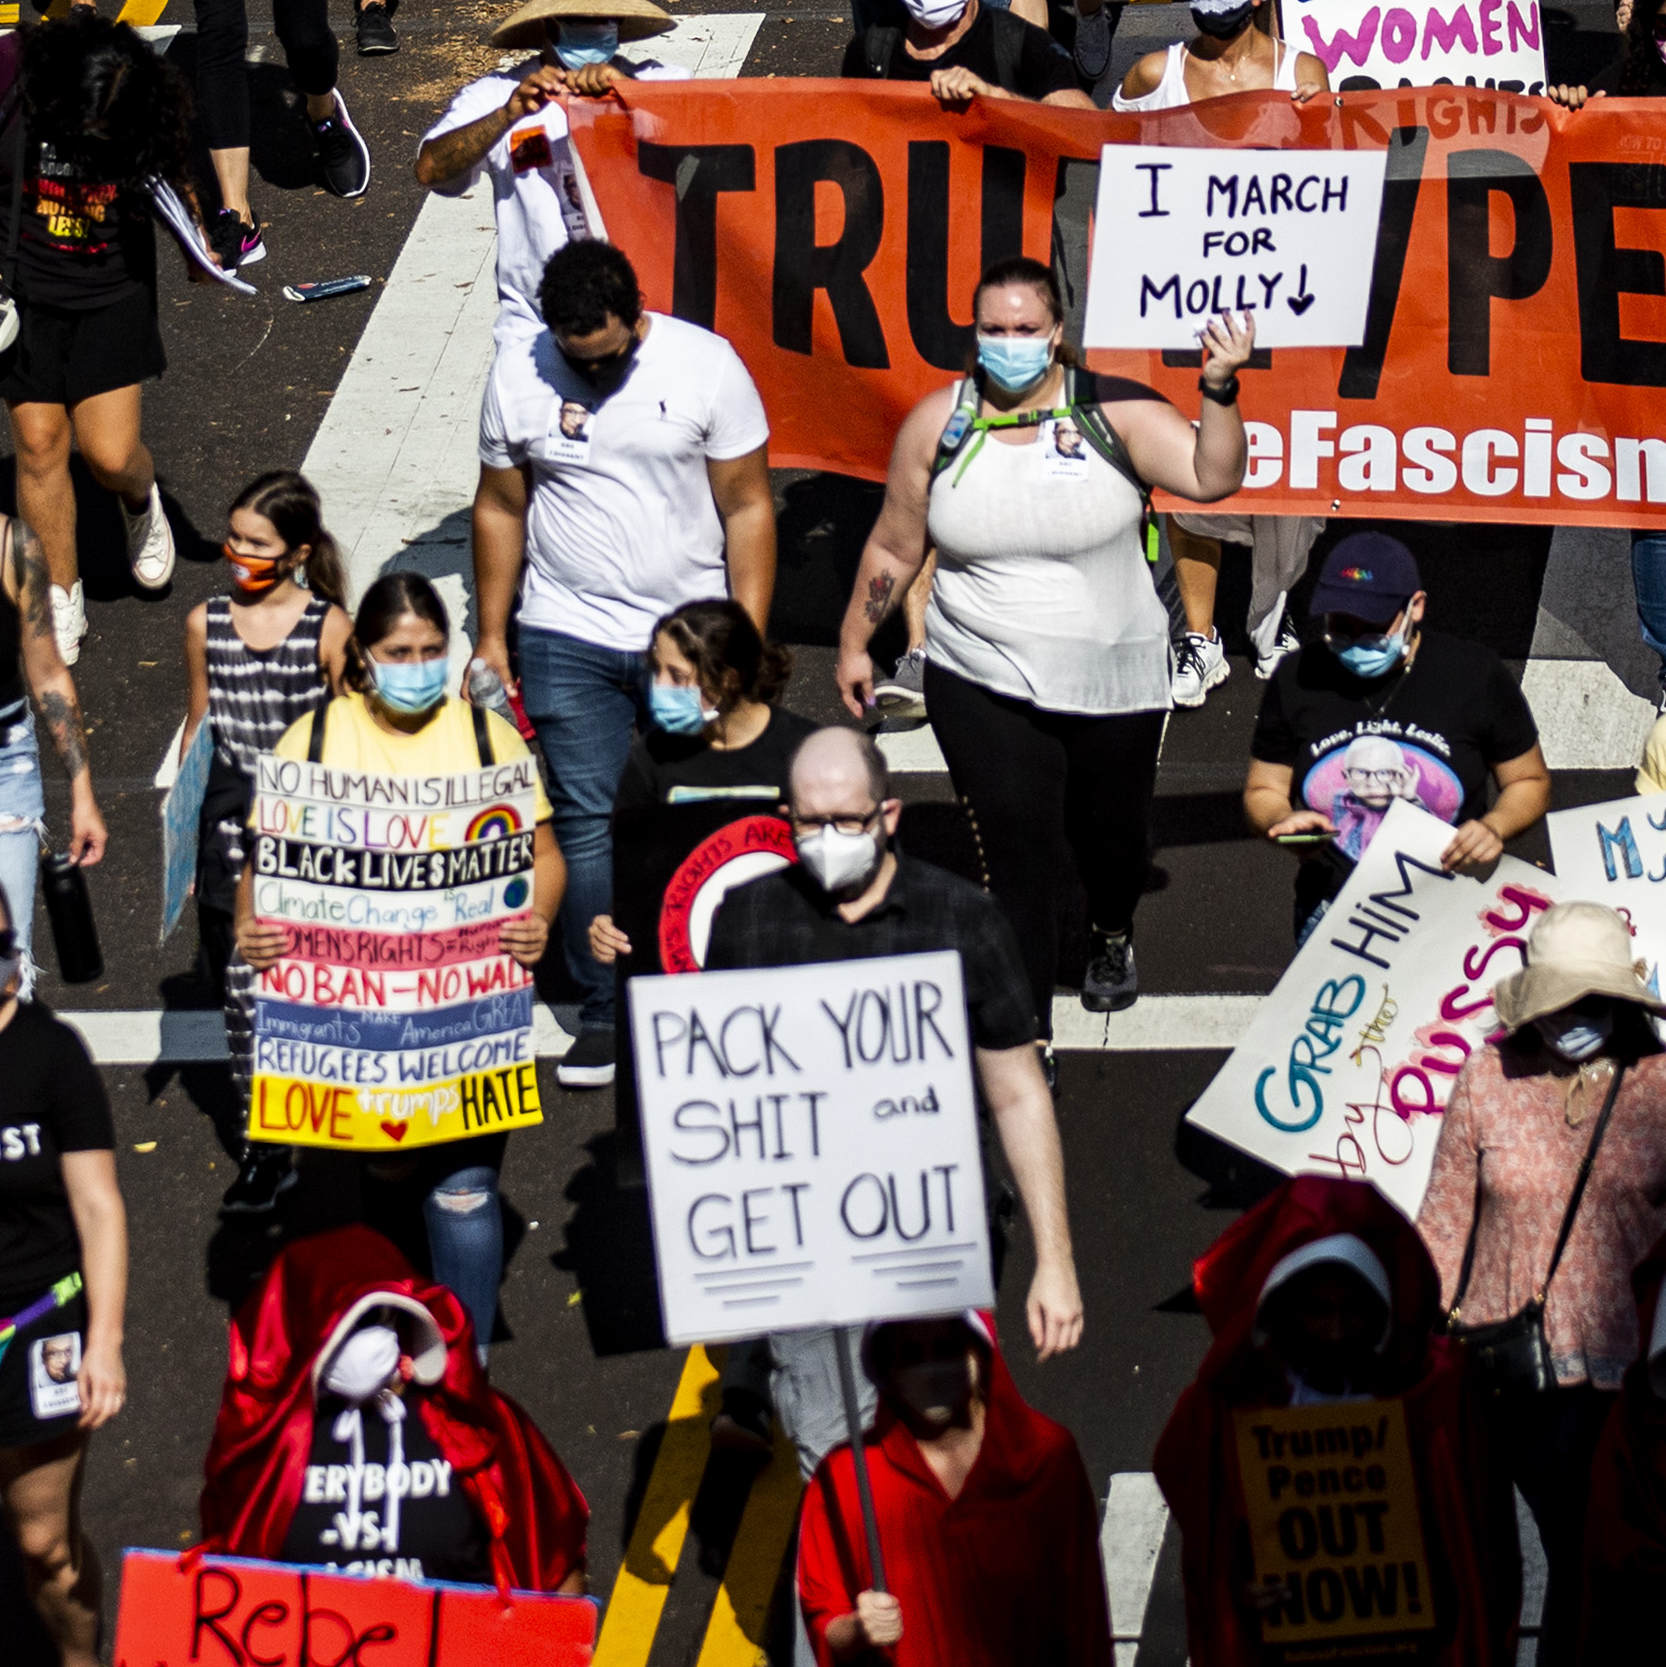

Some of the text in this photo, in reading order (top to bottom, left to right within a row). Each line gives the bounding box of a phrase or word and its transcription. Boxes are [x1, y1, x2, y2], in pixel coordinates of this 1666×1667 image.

[1136, 162, 1349, 217] I MARCH
[1203, 227, 1278, 258] FOR
[1139, 272, 1283, 318] MOLLY
[652, 980, 956, 1078] PACK YOUR
[671, 1091, 940, 1166] SHIT and
[687, 1163, 961, 1260] GET OUT
